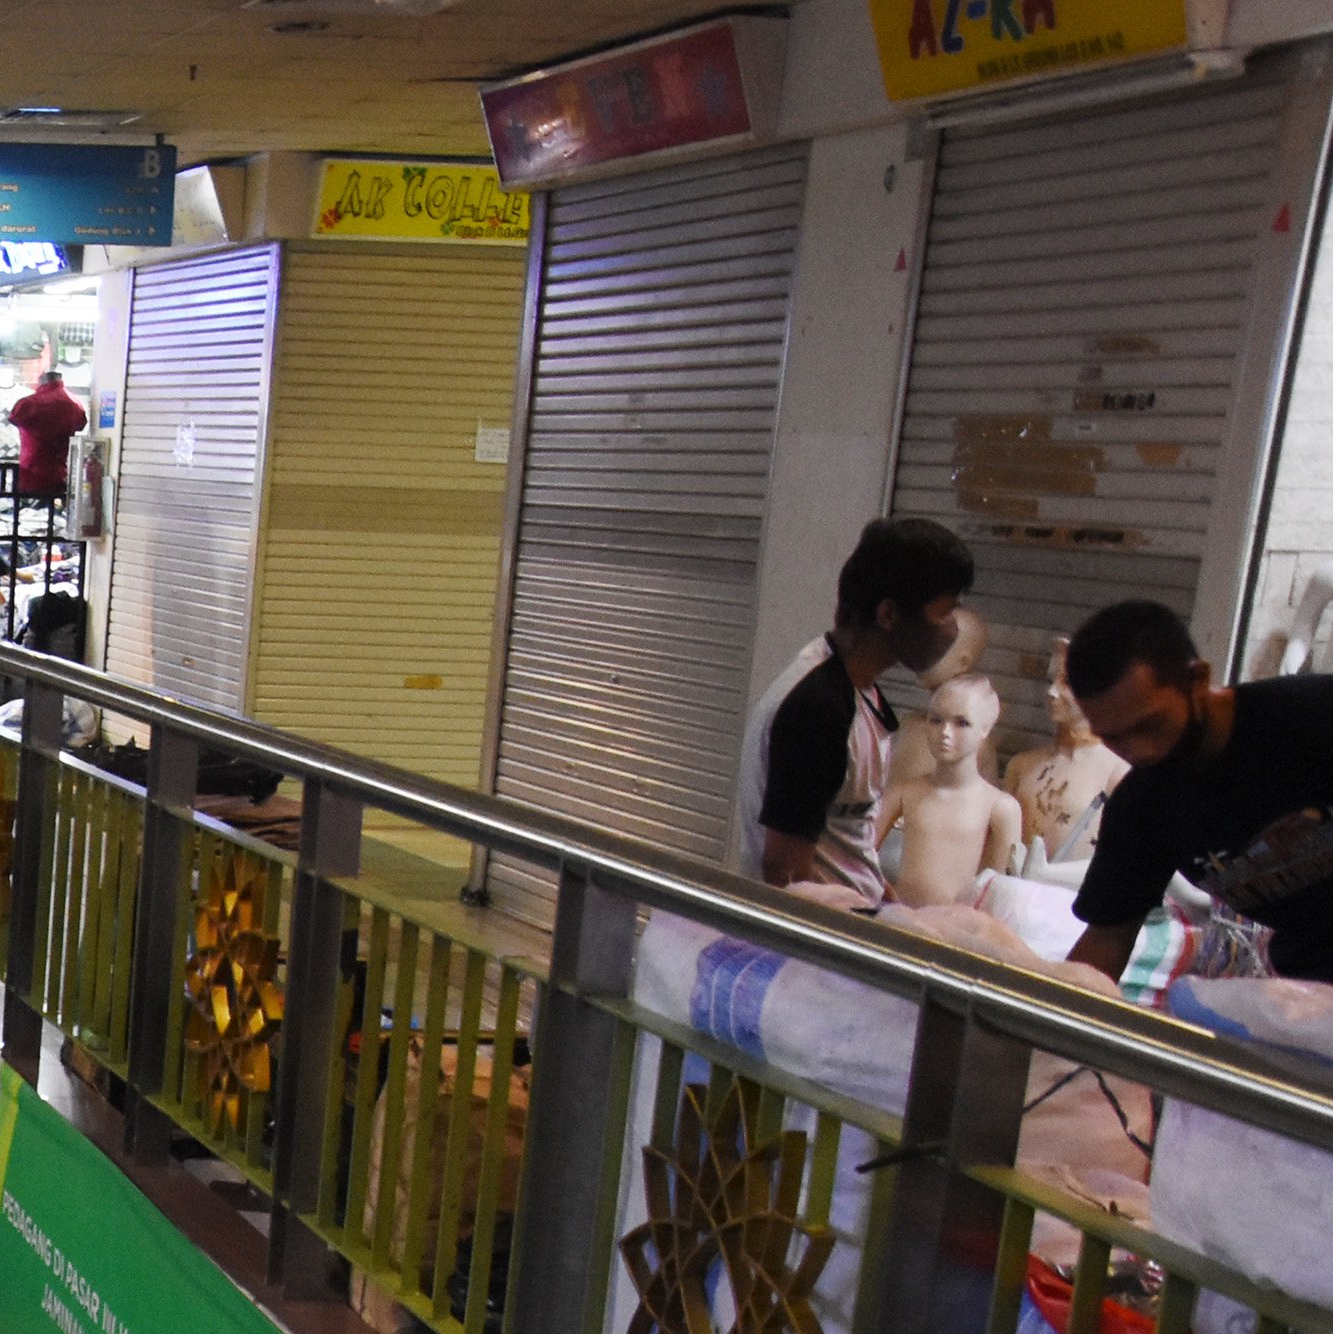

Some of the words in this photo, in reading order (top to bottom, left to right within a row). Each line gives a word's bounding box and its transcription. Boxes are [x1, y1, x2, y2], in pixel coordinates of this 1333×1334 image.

[2, 1188, 52, 1267] PEDAGANG
[52, 1247, 65, 1281] DI
[64, 1261, 100, 1324] PASAR
